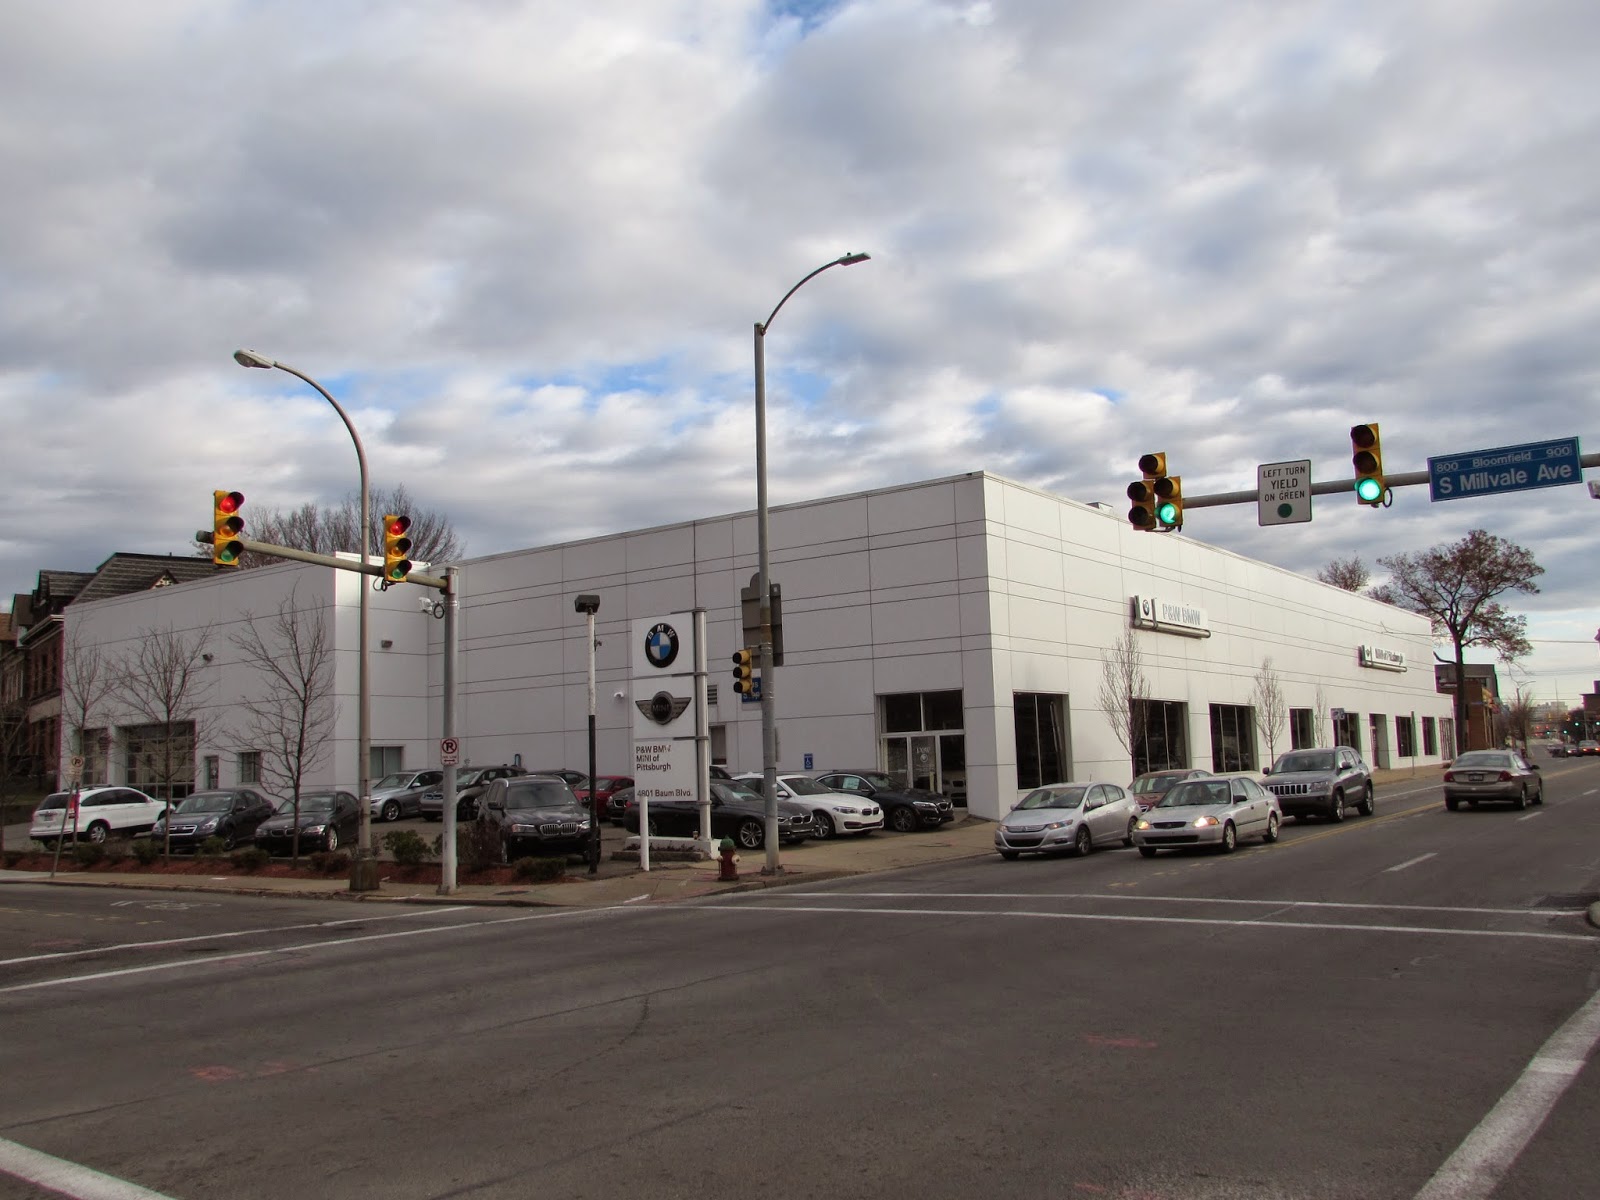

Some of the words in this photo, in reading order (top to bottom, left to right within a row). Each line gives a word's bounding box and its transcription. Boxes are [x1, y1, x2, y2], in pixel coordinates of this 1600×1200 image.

[1436, 462, 1459, 472] 800
[1472, 451, 1532, 468] Bloomfield
[1546, 446, 1570, 458] 900
[1263, 468, 1281, 478] LEFT
[1285, 466, 1305, 475] TURN
[1270, 478, 1298, 489] YIELD
[1439, 477, 1453, 493] S
[1460, 468, 1528, 491] Millvale
[1537, 464, 1572, 481] Ave
[1264, 493, 1275, 502] ON
[1279, 490, 1305, 500] GREEN
[1162, 603, 1181, 621] P&W
[1181, 607, 1201, 625] BMW
[647, 624, 675, 640] BMW
[635, 745, 652, 754] P&W
[652, 754, 660, 762] of
[636, 762, 672, 772] Pittsburgh
[637, 789, 653, 797] 4801
[655, 789, 675, 797] Baum
